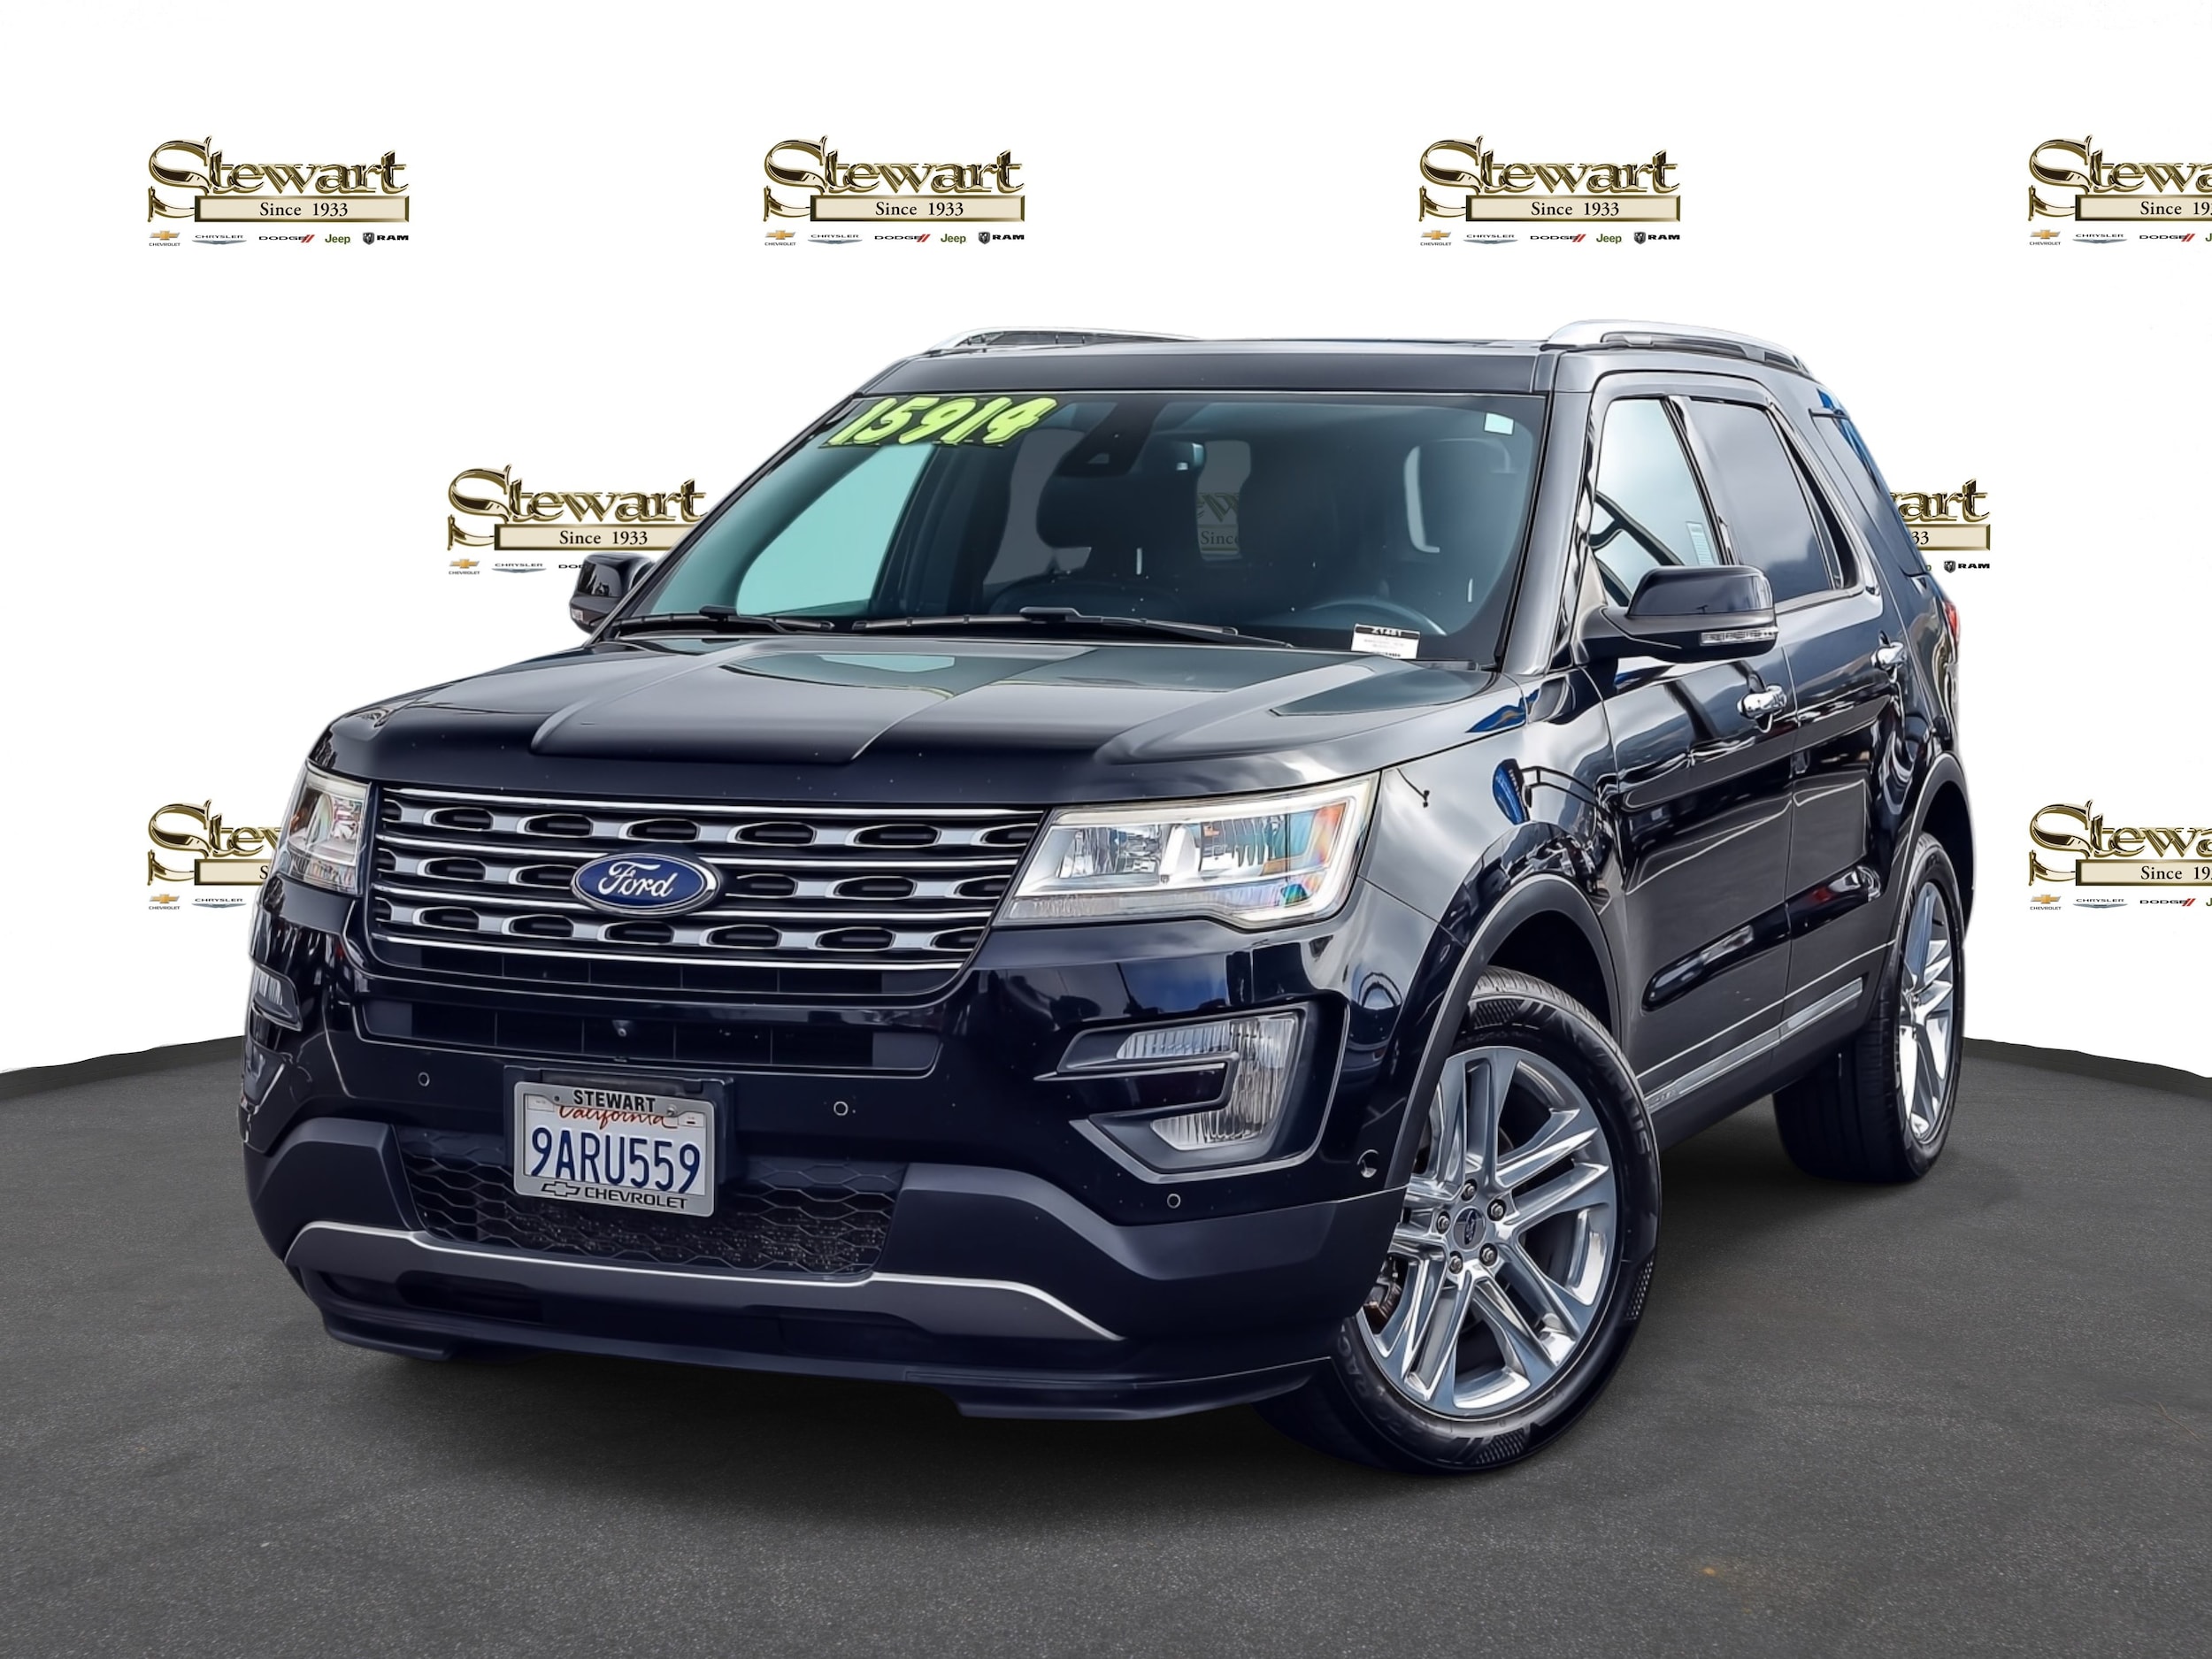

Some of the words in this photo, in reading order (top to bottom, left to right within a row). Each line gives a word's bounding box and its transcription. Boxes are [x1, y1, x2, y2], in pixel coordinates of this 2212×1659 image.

[147, 135, 409, 222] Stewart
[763, 134, 1025, 222] Stewart
[1418, 134, 1680, 222] Stewart
[259, 202, 302, 217] Since
[312, 202, 349, 217] 1933
[875, 202, 918, 216] Since
[928, 202, 964, 217] 1933
[1531, 202, 1573, 216] Since
[1584, 202, 1620, 217] 1933
[2139, 201, 2182, 215] Since
[2193, 202, 2212, 216] 19
[325, 234, 350, 244] Jeep
[941, 234, 966, 244] Jeep
[1595, 234, 1622, 244] Jeep
[447, 464, 708, 550] Stewart
[559, 531, 602, 545] Since
[612, 531, 649, 546] 1933
[598, 861, 679, 897] Ford
[2140, 865, 2183, 879] Since
[2193, 866, 2212, 880] 19
[573, 1089, 656, 1112] STEWART
[559, 1106, 678, 1130] California
[531, 1127, 700, 1194] 9ARU559
[585, 1187, 688, 1210] CHEVROLET
